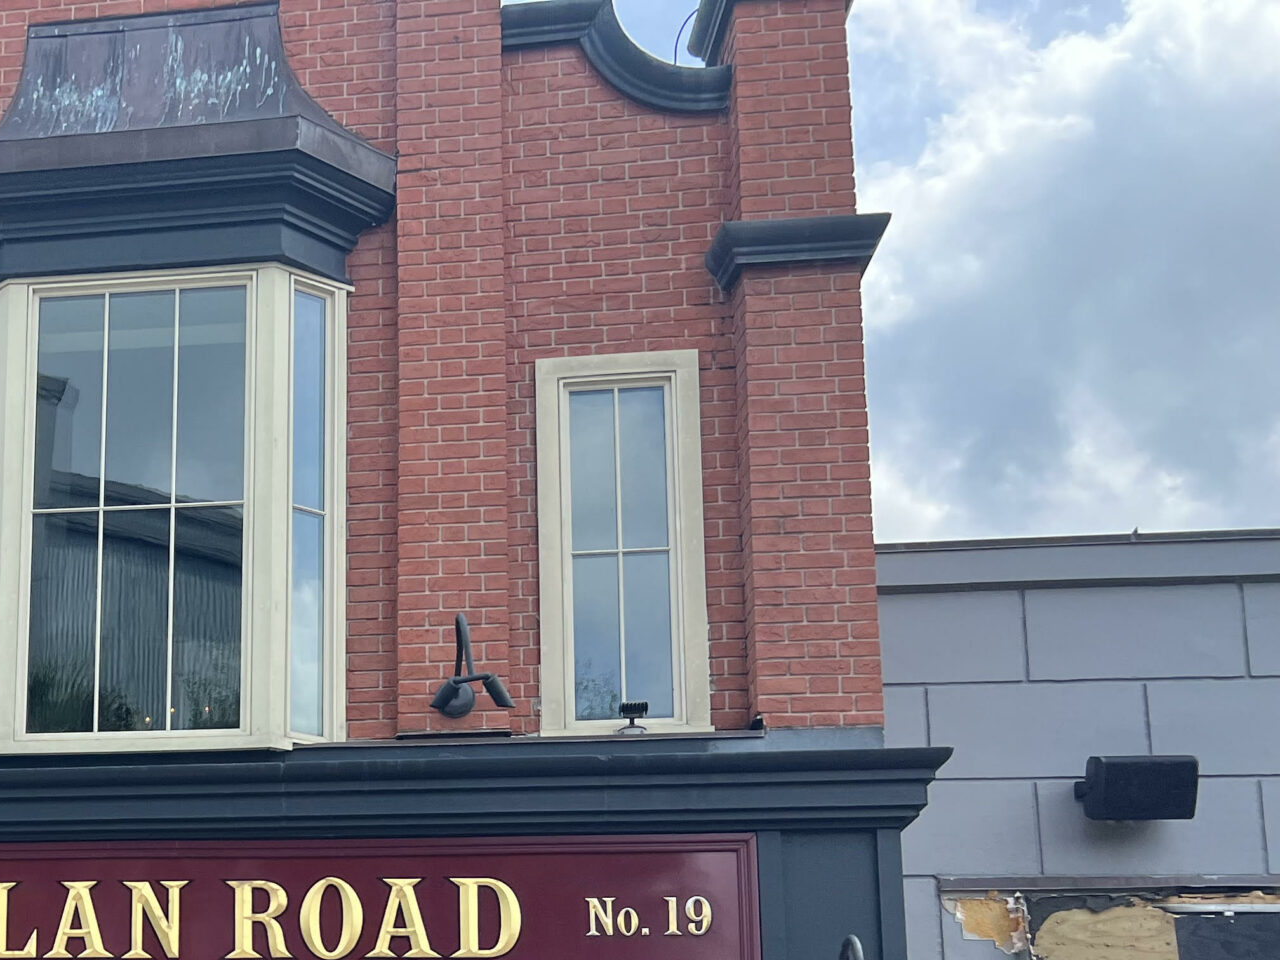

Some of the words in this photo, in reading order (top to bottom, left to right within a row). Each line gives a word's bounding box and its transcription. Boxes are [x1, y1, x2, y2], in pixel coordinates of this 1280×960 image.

[222, 875, 523, 960] ROAD
[584, 897, 651, 937] No.
[663, 896, 713, 936] 19
